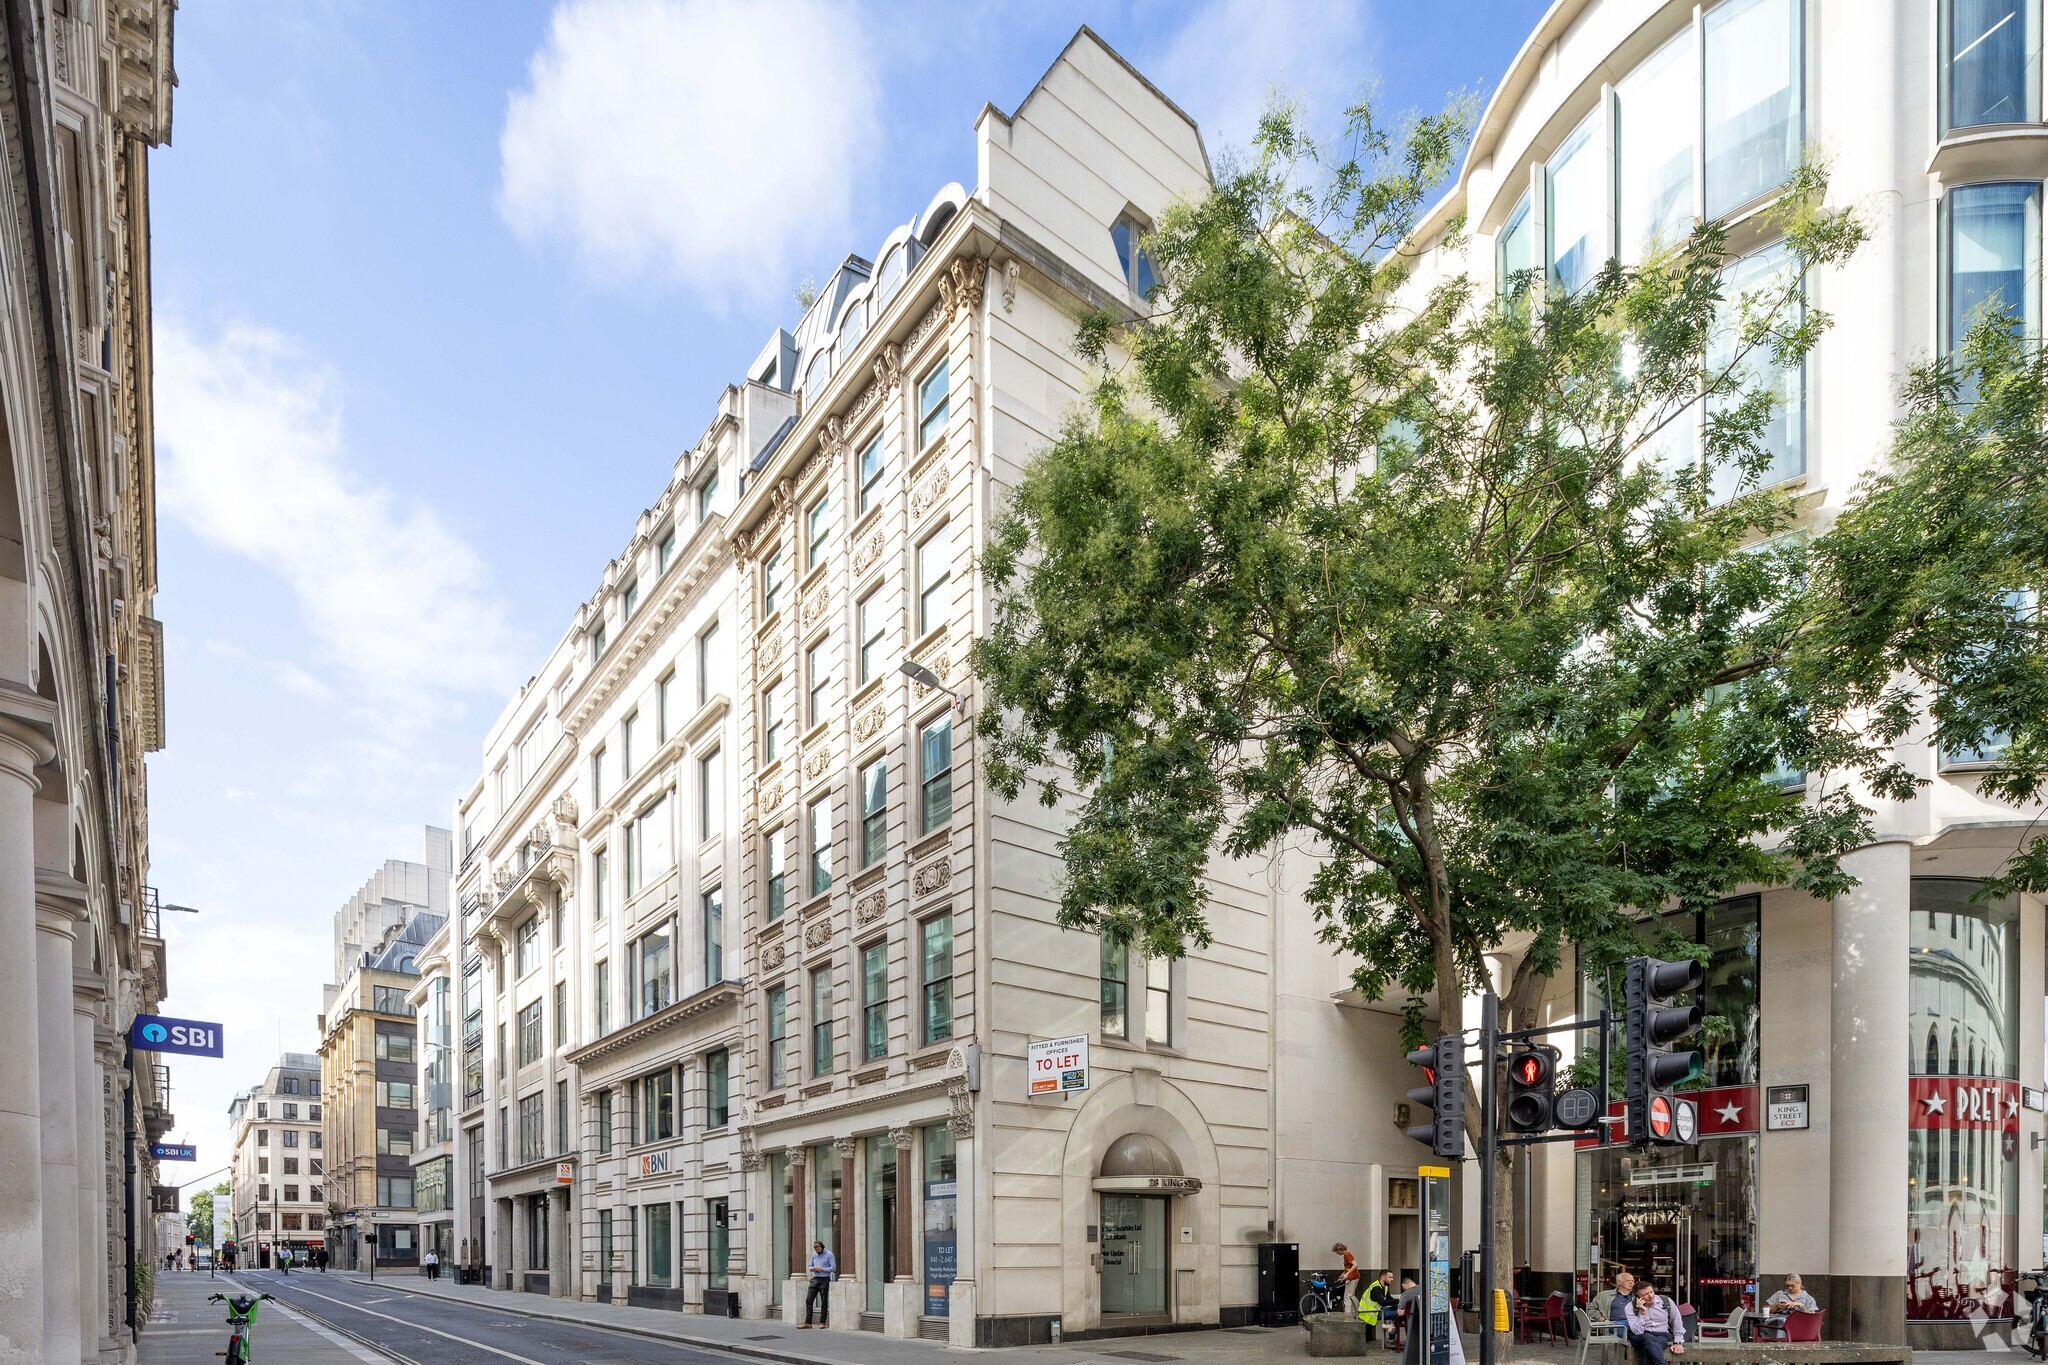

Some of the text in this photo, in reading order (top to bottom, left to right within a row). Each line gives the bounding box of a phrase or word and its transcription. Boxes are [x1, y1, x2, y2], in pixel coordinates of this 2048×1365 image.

[171, 1026, 214, 1048] SBI
[1054, 1038, 1084, 1047] FURNISHED
[1036, 1054, 1079, 1071] TO LET
[1957, 1086, 2000, 1121] PRET
[1677, 1113, 1692, 1123] Except
[1773, 1112, 1803, 1120] STREET
[1678, 1124, 1692, 1132] cycles
[165, 1148, 179, 1156] SBI
[650, 1152, 668, 1173] BNI
[1149, 1178, 1159, 1187] 28
[1161, 1178, 1184, 1188] KING
[157, 1194, 175, 1210] 14
[938, 1246, 953, 1254] TO LET
